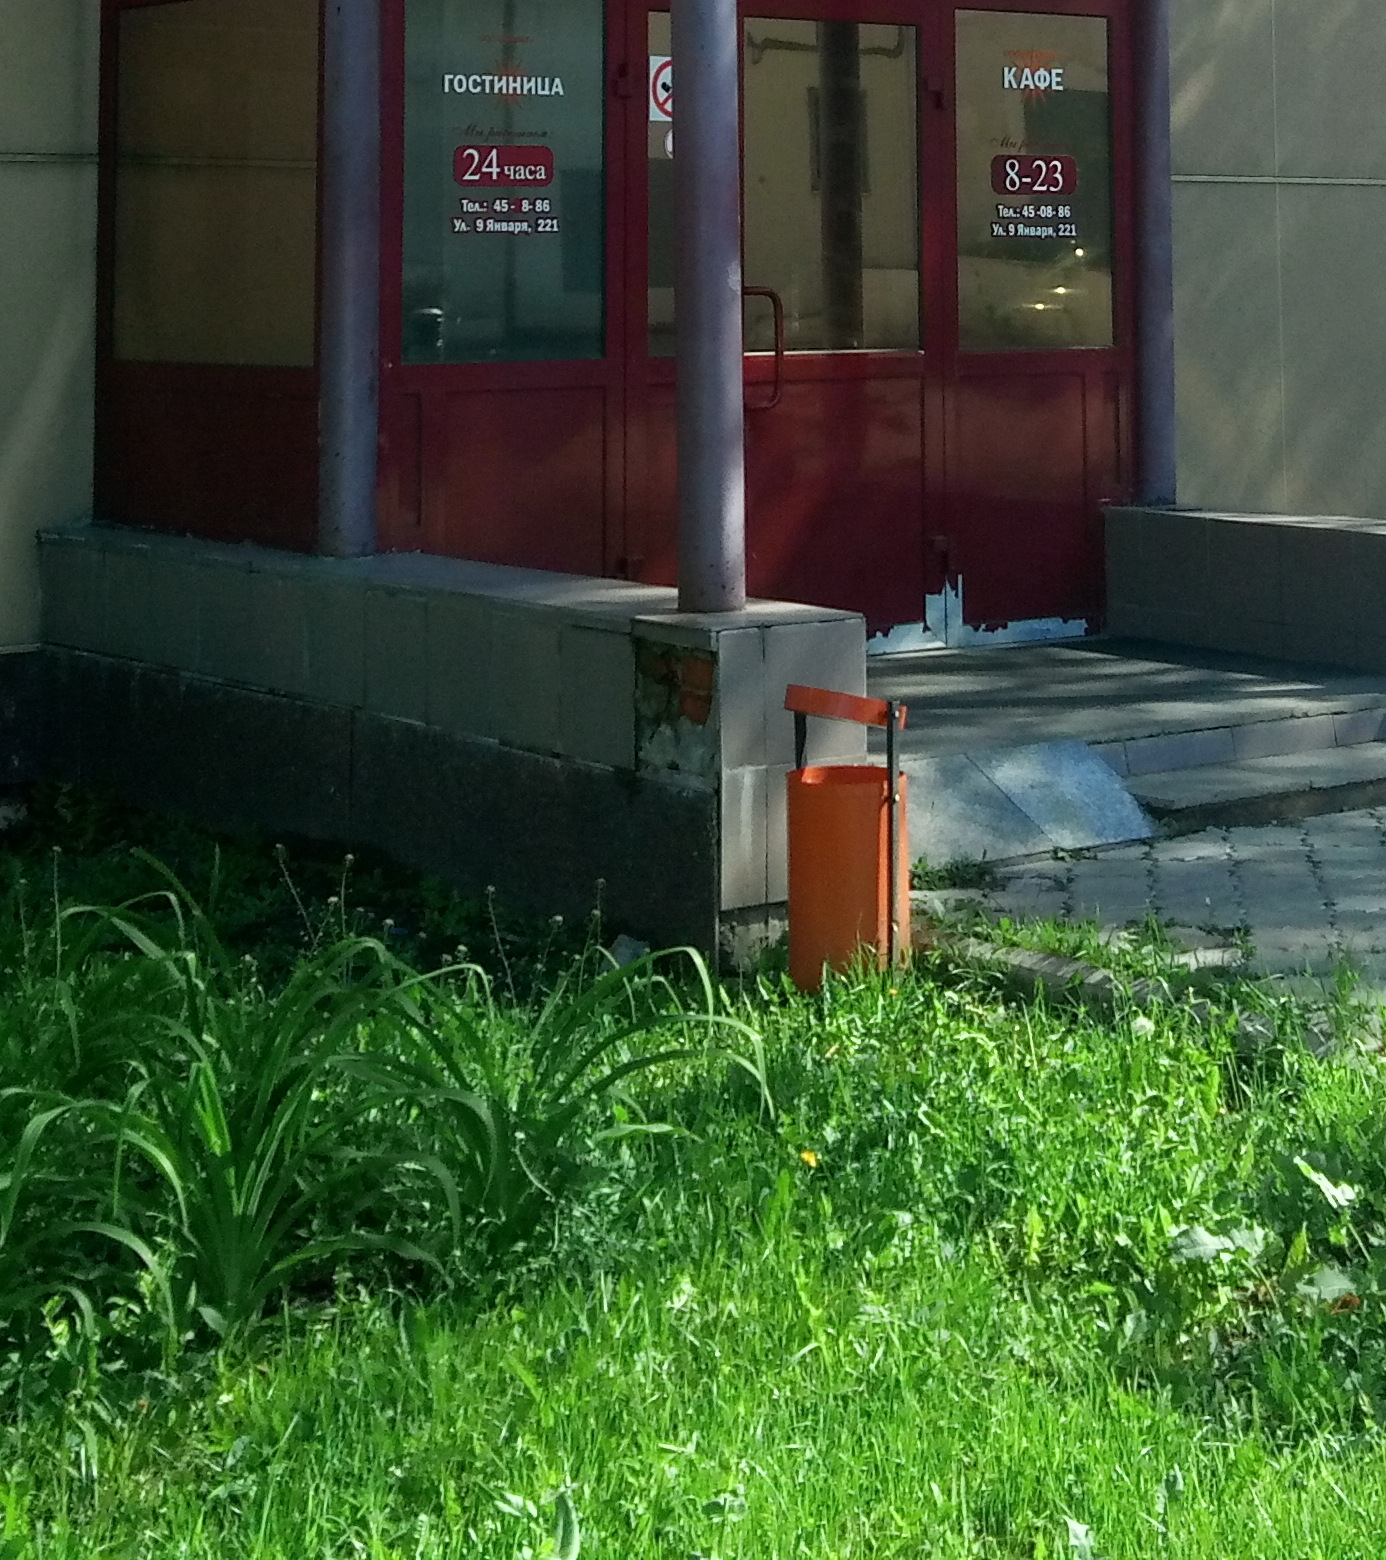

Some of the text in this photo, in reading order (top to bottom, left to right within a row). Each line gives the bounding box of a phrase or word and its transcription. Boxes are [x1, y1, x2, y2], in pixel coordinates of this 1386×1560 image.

[443, 74, 564, 96] ГОСТИНИЦА
[1003, 67, 1063, 90] КАФЕ
[462, 148, 546, 180] 24 часа
[1005, 159, 1063, 191] 8-23
[997, 205, 1020, 217] Тел.:
[453, 219, 470, 232] Ул.
[476, 219, 484, 231] 9
[537, 219, 559, 232] 221
[992, 224, 1006, 236] Ул.
[1008, 224, 1015, 236] 9
[1058, 224, 1077, 236] 221
